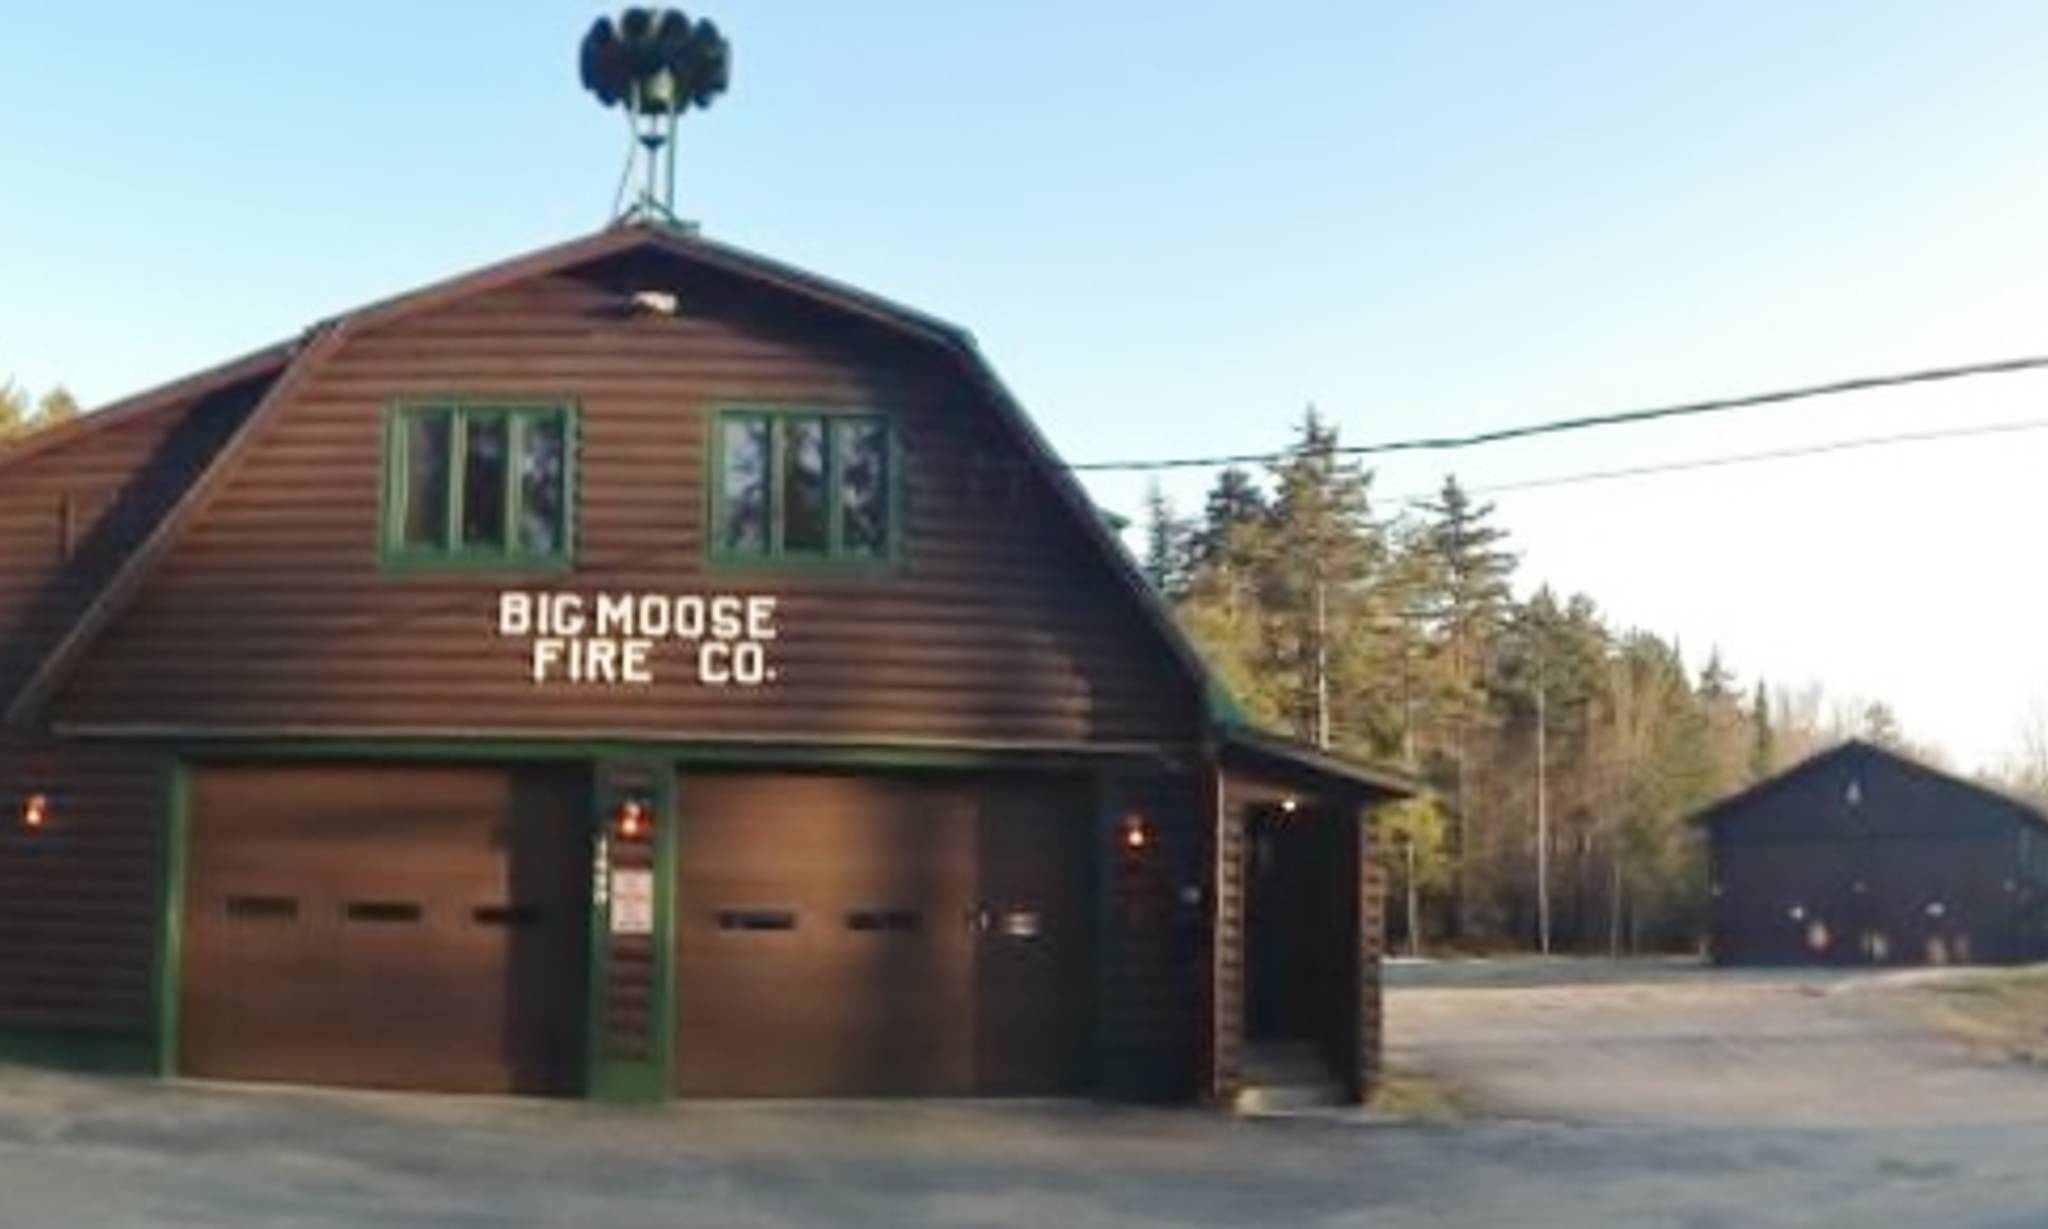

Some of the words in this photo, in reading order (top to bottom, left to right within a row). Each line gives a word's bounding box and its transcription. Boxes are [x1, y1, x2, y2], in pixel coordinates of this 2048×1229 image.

[500, 592, 585, 635] BIG
[596, 592, 777, 639] MOOSE
[533, 638, 653, 682] FIRE
[699, 641, 777, 683] CO.
